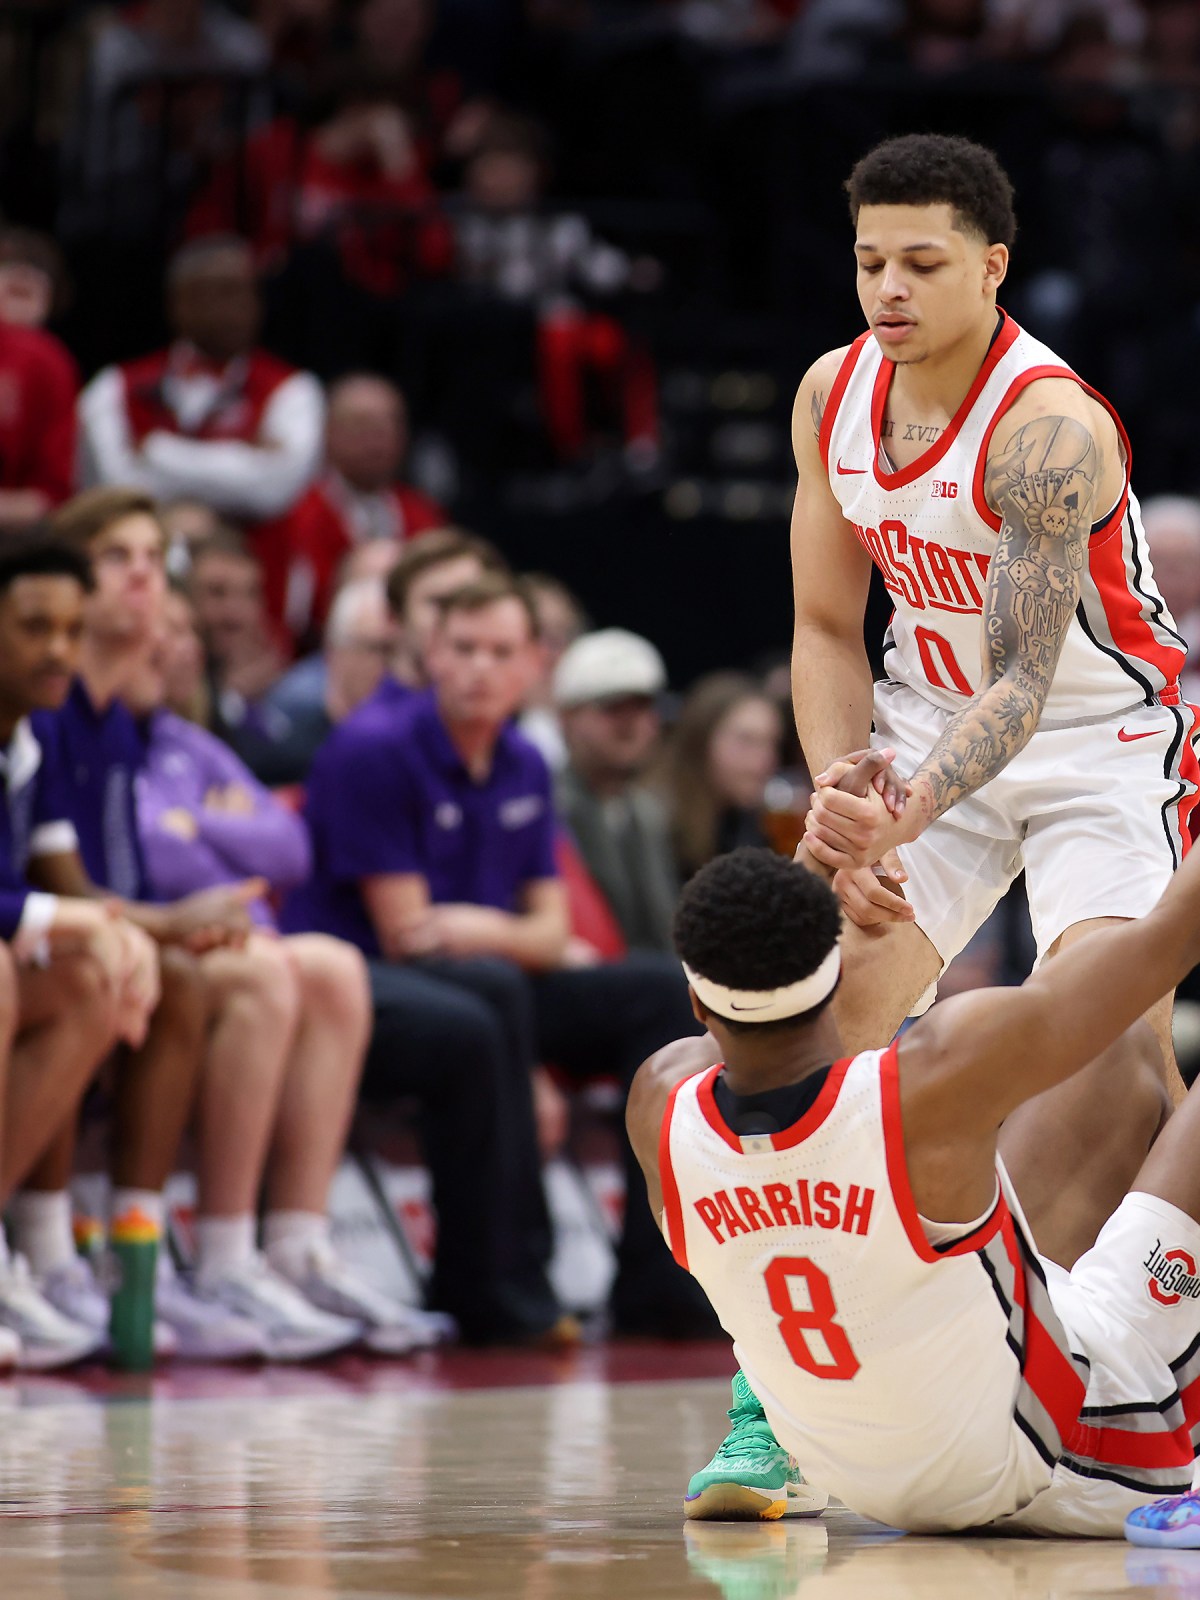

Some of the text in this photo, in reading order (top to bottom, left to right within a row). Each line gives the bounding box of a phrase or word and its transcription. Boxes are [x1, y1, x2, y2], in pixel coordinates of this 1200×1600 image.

[913, 624, 975, 698] 0
[694, 1179, 876, 1245] PARRISH
[763, 1256, 863, 1381] 8
